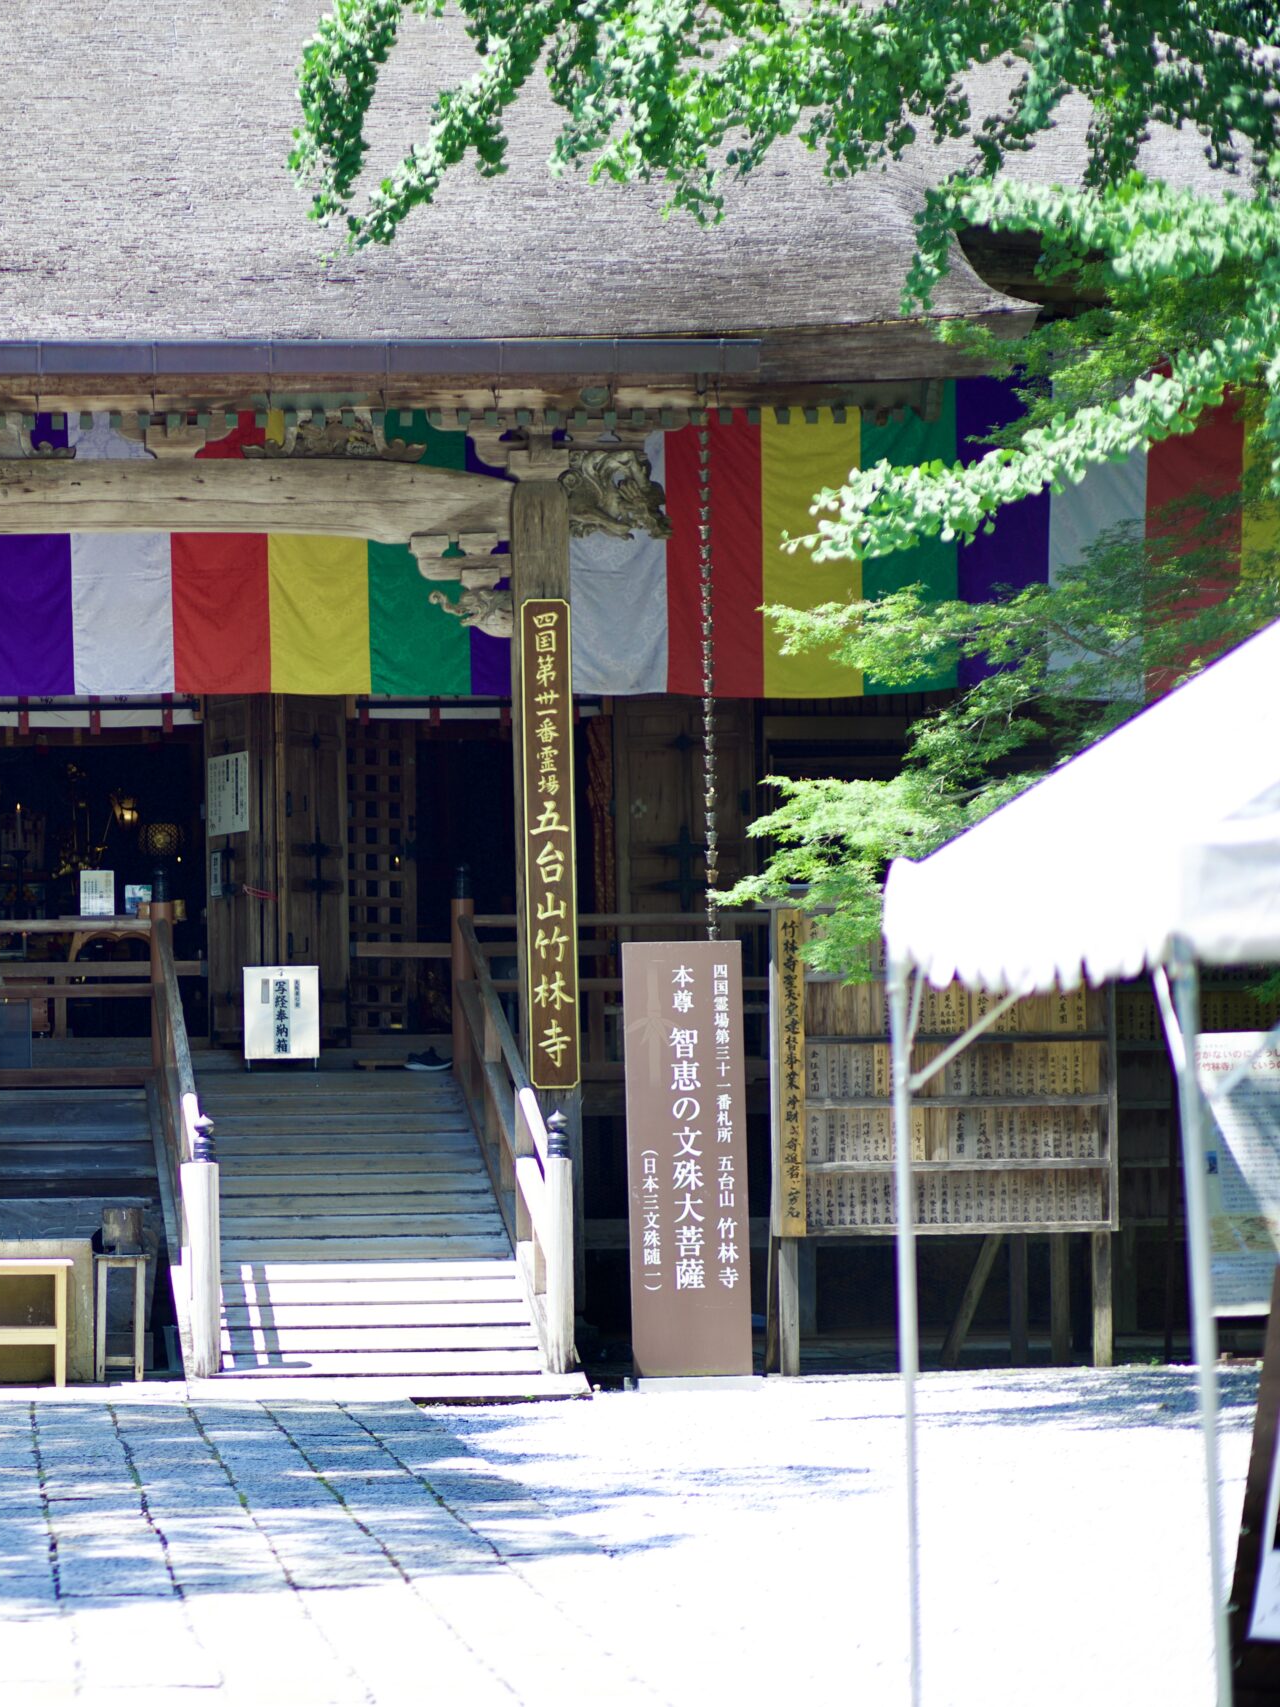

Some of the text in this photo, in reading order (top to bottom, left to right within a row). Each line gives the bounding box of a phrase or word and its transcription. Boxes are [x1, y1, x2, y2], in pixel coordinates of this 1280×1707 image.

[274, 980, 289, 1053] 写経奉納箱
[669, 965, 706, 1289] 本尊 智恵の文殊大菩薩
[713, 964, 739, 1288] 四国霊場第三十一番札所 五台山 竹林寺
